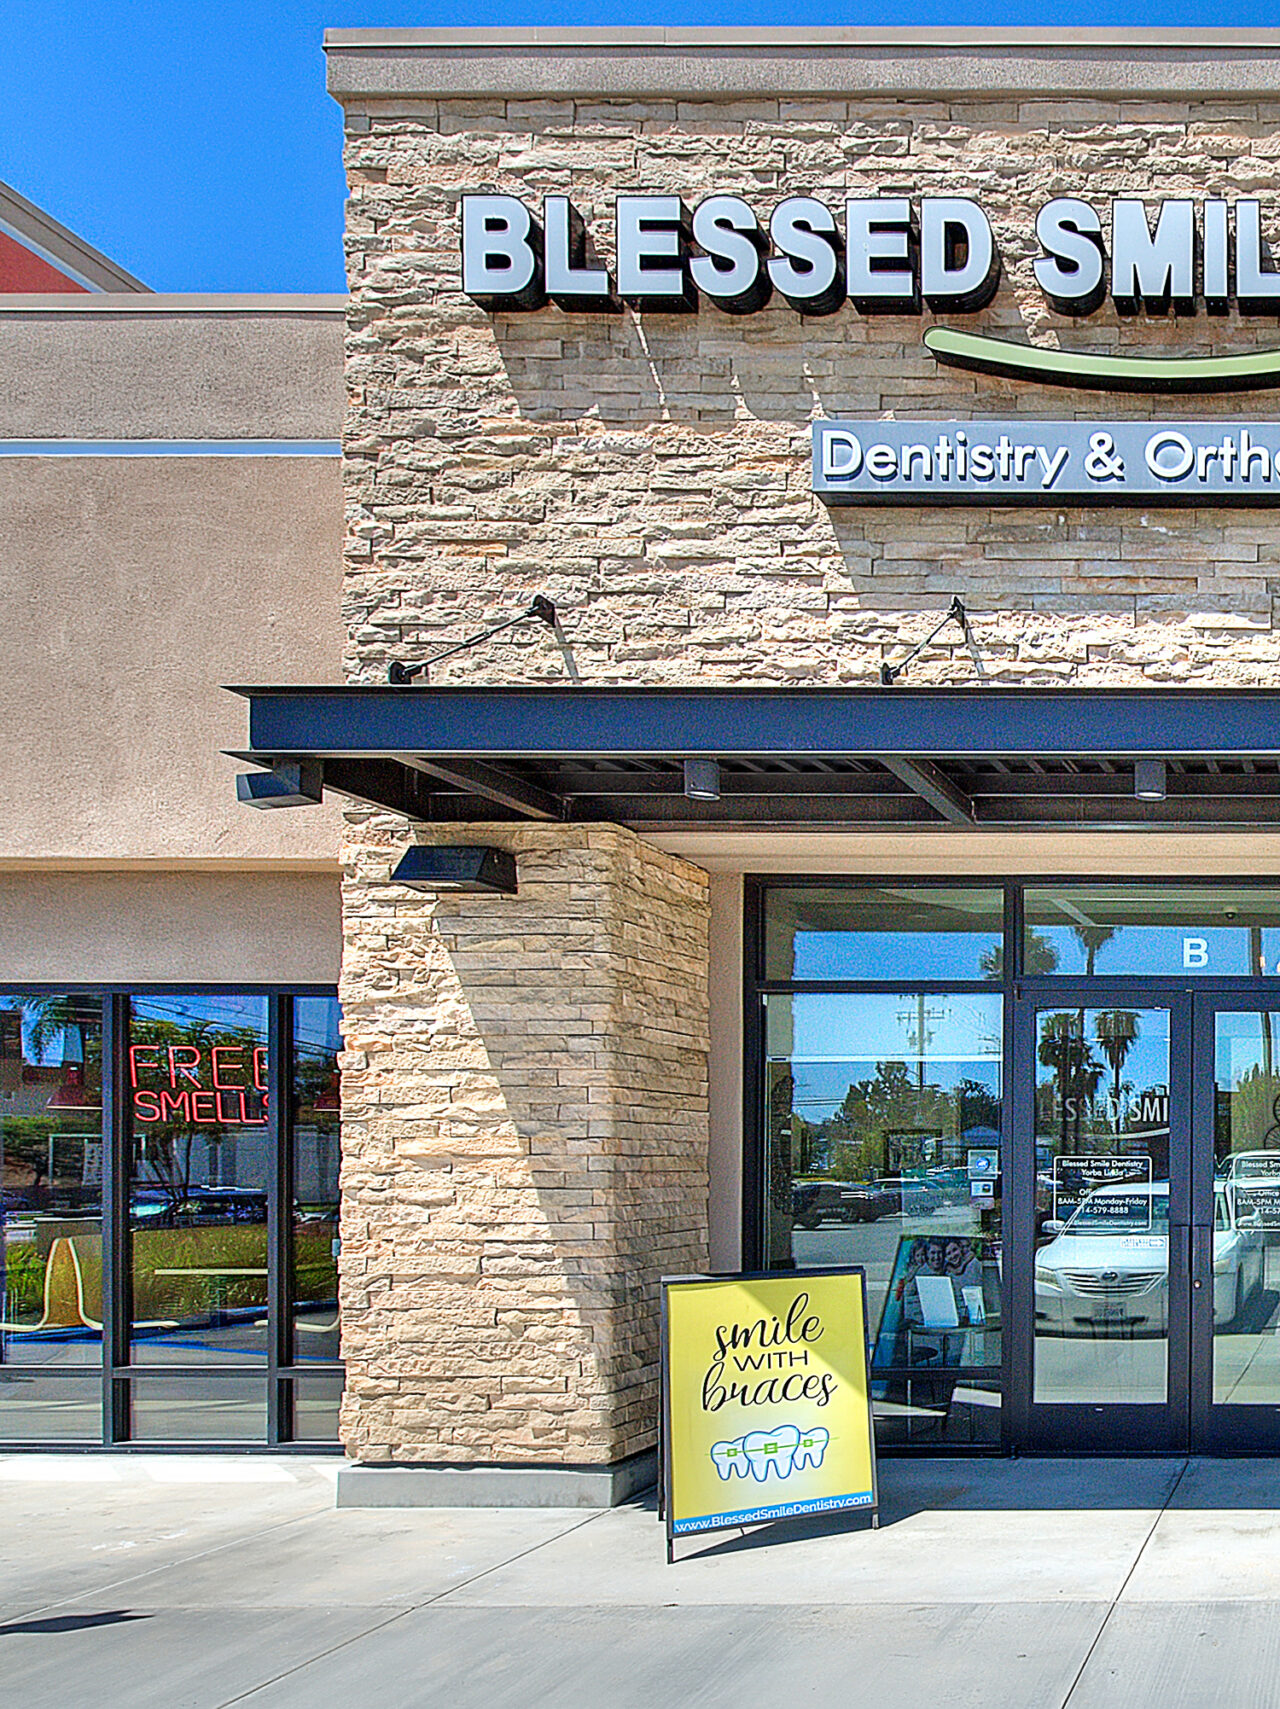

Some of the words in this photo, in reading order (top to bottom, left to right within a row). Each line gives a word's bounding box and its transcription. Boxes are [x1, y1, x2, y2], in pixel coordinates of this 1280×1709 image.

[461, 195, 996, 301] BLESSED
[822, 430, 1070, 487] Dentistry
[1084, 431, 1126, 480] &
[1183, 937, 1209, 968] B
[133, 1091, 269, 1124] SMELL
[1129, 1097, 1169, 1122] SMI
[1062, 1160, 1088, 1168] Blessed
[1090, 1160, 1110, 1168] Smile
[1111, 1160, 1144, 1169] Dentistry
[1241, 1160, 1268, 1168] Blessed
[713, 1292, 824, 1361] smile
[733, 1350, 807, 1371] WITH
[702, 1361, 838, 1411] braces
[675, 1494, 872, 1532] www.BlessedSmileDentistry.com
